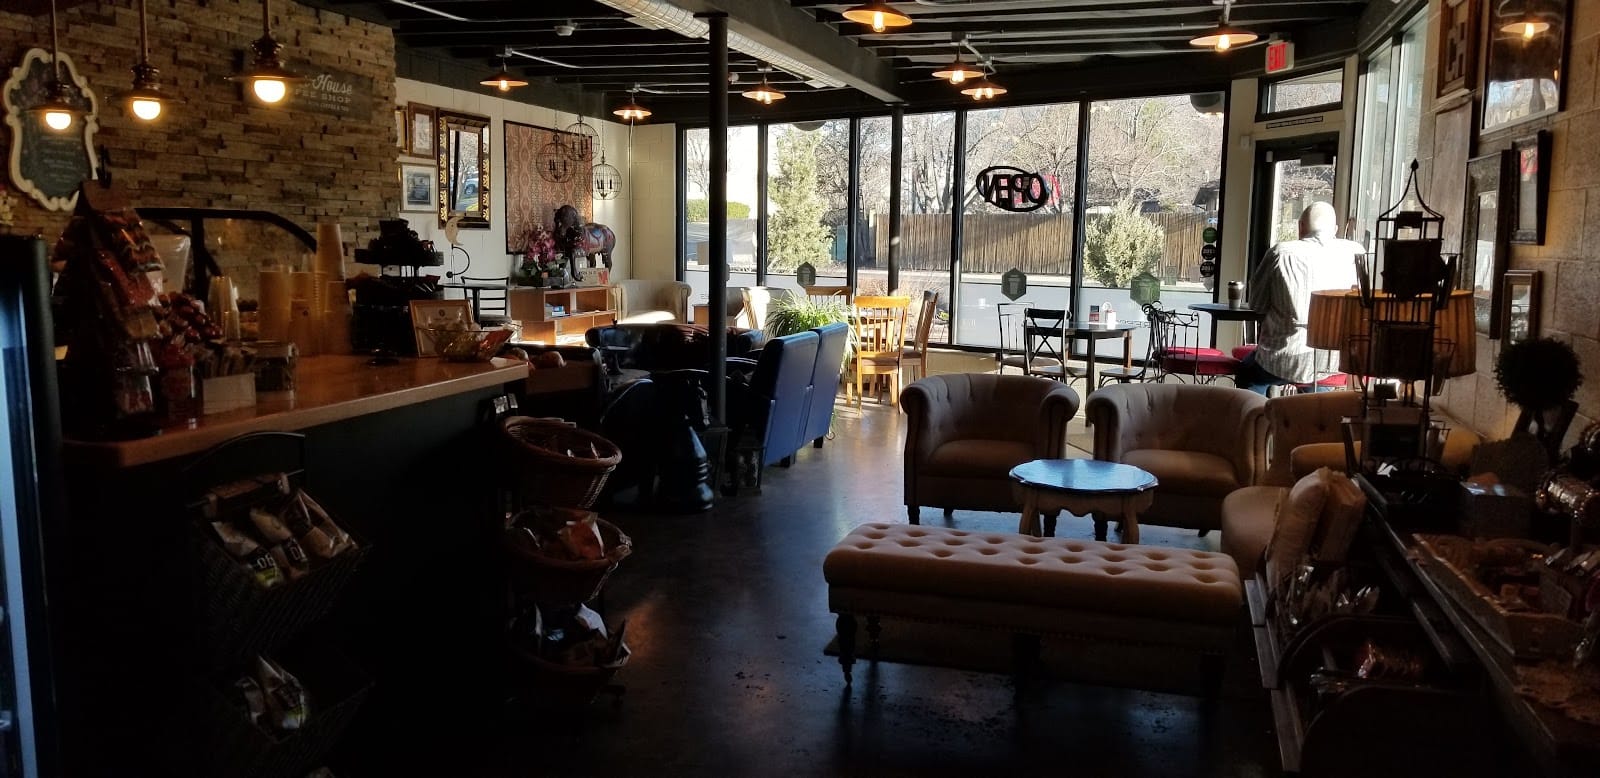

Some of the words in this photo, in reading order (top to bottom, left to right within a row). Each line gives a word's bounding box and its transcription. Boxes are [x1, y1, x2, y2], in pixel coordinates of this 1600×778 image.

[1269, 43, 1287, 71] EXIT
[312, 74, 353, 94] House
[321, 93, 352, 104] SHOP
